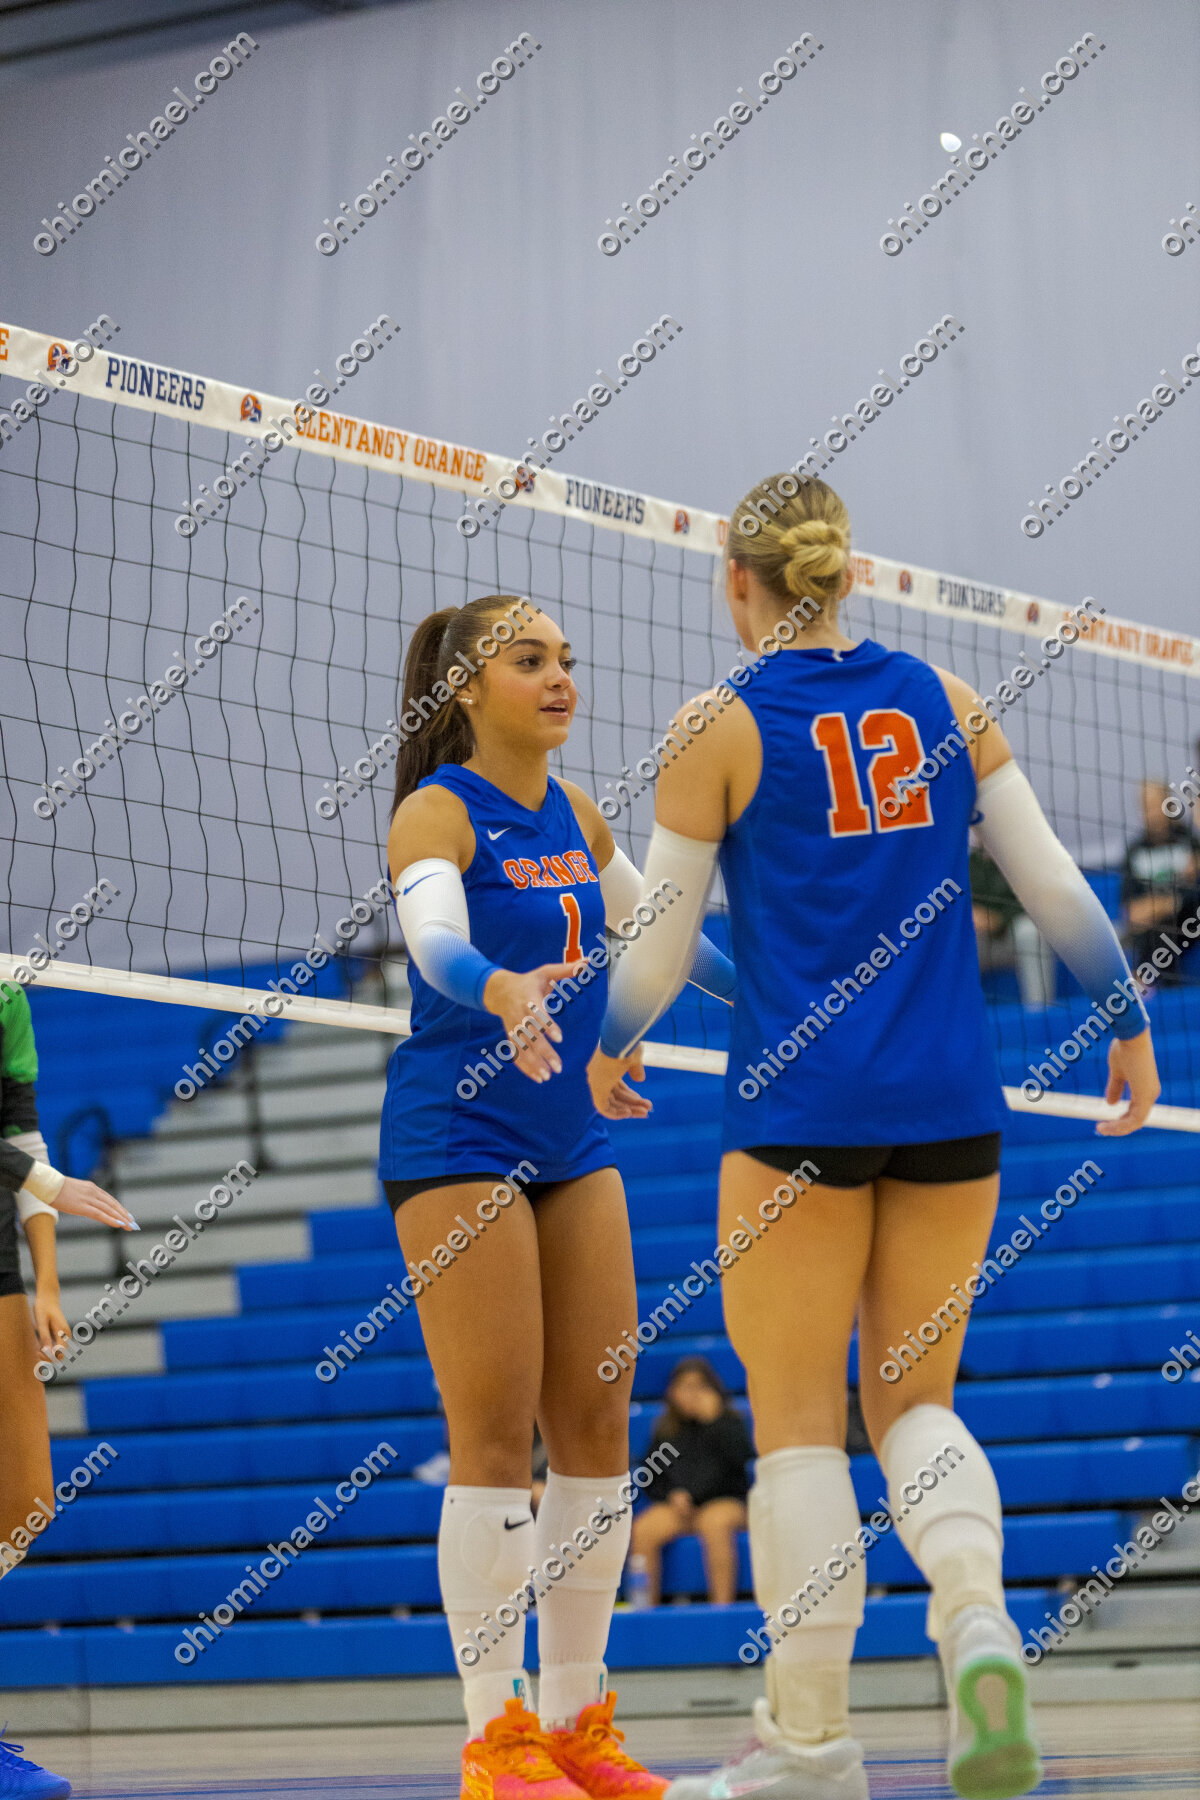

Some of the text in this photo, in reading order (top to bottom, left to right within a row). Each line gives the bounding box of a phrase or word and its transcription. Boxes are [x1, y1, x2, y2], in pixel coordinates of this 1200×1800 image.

[105, 356, 207, 411] PIONEERS
[295, 405, 488, 482] OLENTANGY ORANGE
[810, 708, 934, 838] 12
[503, 850, 598, 890] ORANGE
[559, 892, 585, 964] 1
